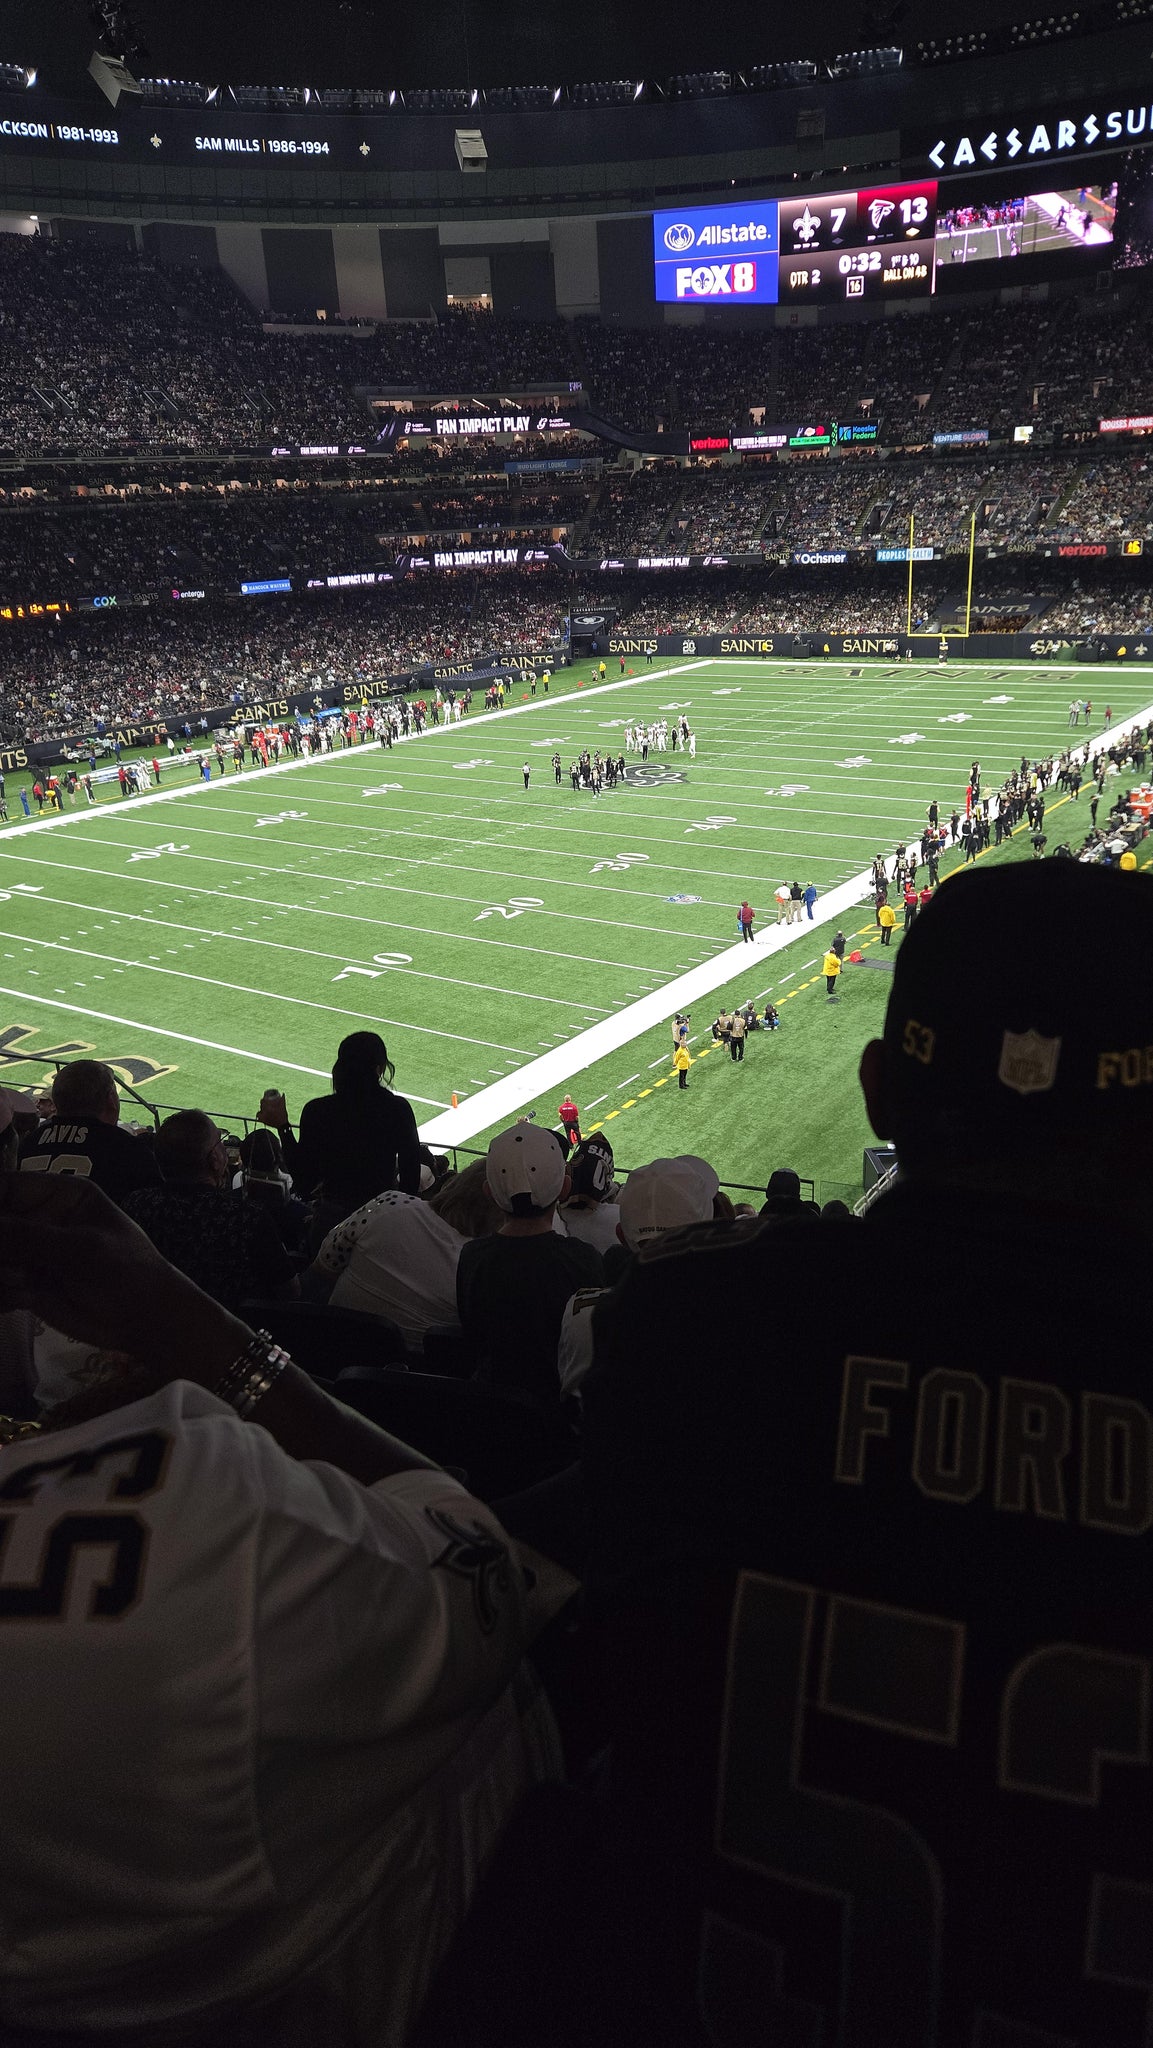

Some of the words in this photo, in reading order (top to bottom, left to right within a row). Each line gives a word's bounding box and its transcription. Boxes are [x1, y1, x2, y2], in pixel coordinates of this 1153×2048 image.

[57, 126, 119, 144] 1981-1993
[929, 114, 1100, 169] CAESARS
[1106, 105, 1153, 139] SU
[195, 136, 222, 151] SAM
[225, 138, 260, 152] MILLS
[268, 140, 330, 154] 1986-1994
[899, 197, 929, 223] 13
[830, 207, 847, 234] 7
[838, 252, 882, 275] 0:32
[677, 264, 733, 298] FOX
[789, 270, 808, 288] QTR
[811, 269, 821, 285] 2
[883, 268, 901, 282] BALL
[902, 267, 914, 280] ON
[436, 418, 457, 434] FAN
[458, 417, 501, 433] IMPACT
[503, 416, 530, 432] PLAY
[852, 431, 877, 440] Federal
[934, 433, 963, 443] VENTURE
[963, 431, 987, 441] GLOBAL
[691, 437, 729, 450] verizon
[15, 449, 44, 458] SAINTS
[77, 448, 105, 457] SAINTS
[136, 447, 164, 456] SAINTS
[193, 447, 219, 456] SAINTS
[1007, 541, 1037, 553] SAINTS
[1058, 544, 1107, 557] verizon
[434, 553, 453, 567] FAN
[454, 551, 493, 566] IMPACT
[494, 549, 518, 563] PLAY
[764, 552, 790, 561] SAINTS
[800, 553, 846, 565] Ochsner
[878, 550, 906, 560] PEOPLES
[638, 558, 650, 568] FAN
[650, 557, 674, 567] IMPACT
[674, 557, 690, 567] PLAY
[327, 576, 339, 586] FAN
[339, 575, 361, 586] IMPACT
[361, 573, 375, 584] PLAY
[93, 595, 118, 608] COX
[181, 589, 205, 600] entergy
[954, 603, 1031, 614] SAINTS
[609, 639, 658, 653] SAINTS
[720, 639, 774, 653] SAINTS
[500, 655, 555, 669] SAINTS
[434, 664, 473, 678] SAINTS
[343, 679, 389, 701] SAINTS
[235, 699, 289, 720] SAINTS
[764, 784, 811, 797] 50
[256, 810, 309, 825] 30
[690, 815, 738, 831] 40
[131, 842, 191, 860] 20
[593, 852, 650, 871] 30
[480, 896, 545, 920] 20
[340, 952, 413, 979] 10
[902, 1018, 936, 1065] 53
[37, 1125, 89, 1146] DAVIS
[833, 1353, 1153, 1536] FORD
